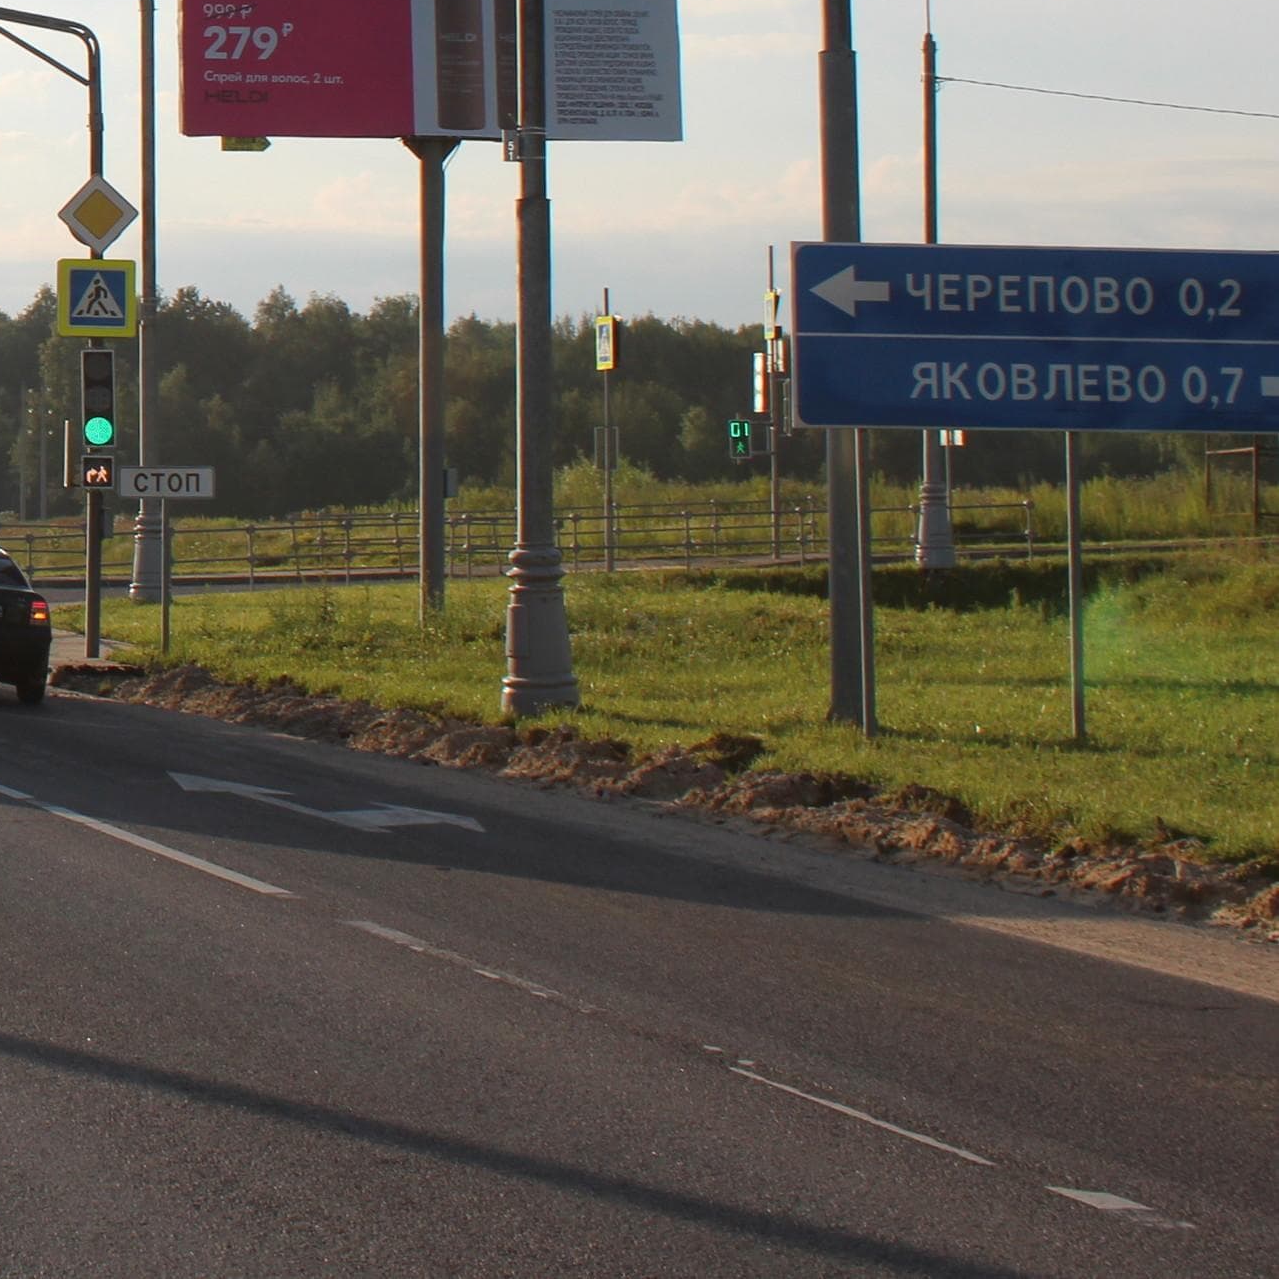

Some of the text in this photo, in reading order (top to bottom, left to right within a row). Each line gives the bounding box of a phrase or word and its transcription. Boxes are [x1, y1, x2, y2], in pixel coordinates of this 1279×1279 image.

[204, 70, 344, 85] Спрей для волос, 2 шт.
[905, 273, 1243, 322] ЧЕРЕПОВО 0,2
[909, 362, 1244, 410] ЯКОВЛЕВО 0,7
[730, 422, 749, 438] 01
[133, 473, 200, 493] СТОП
